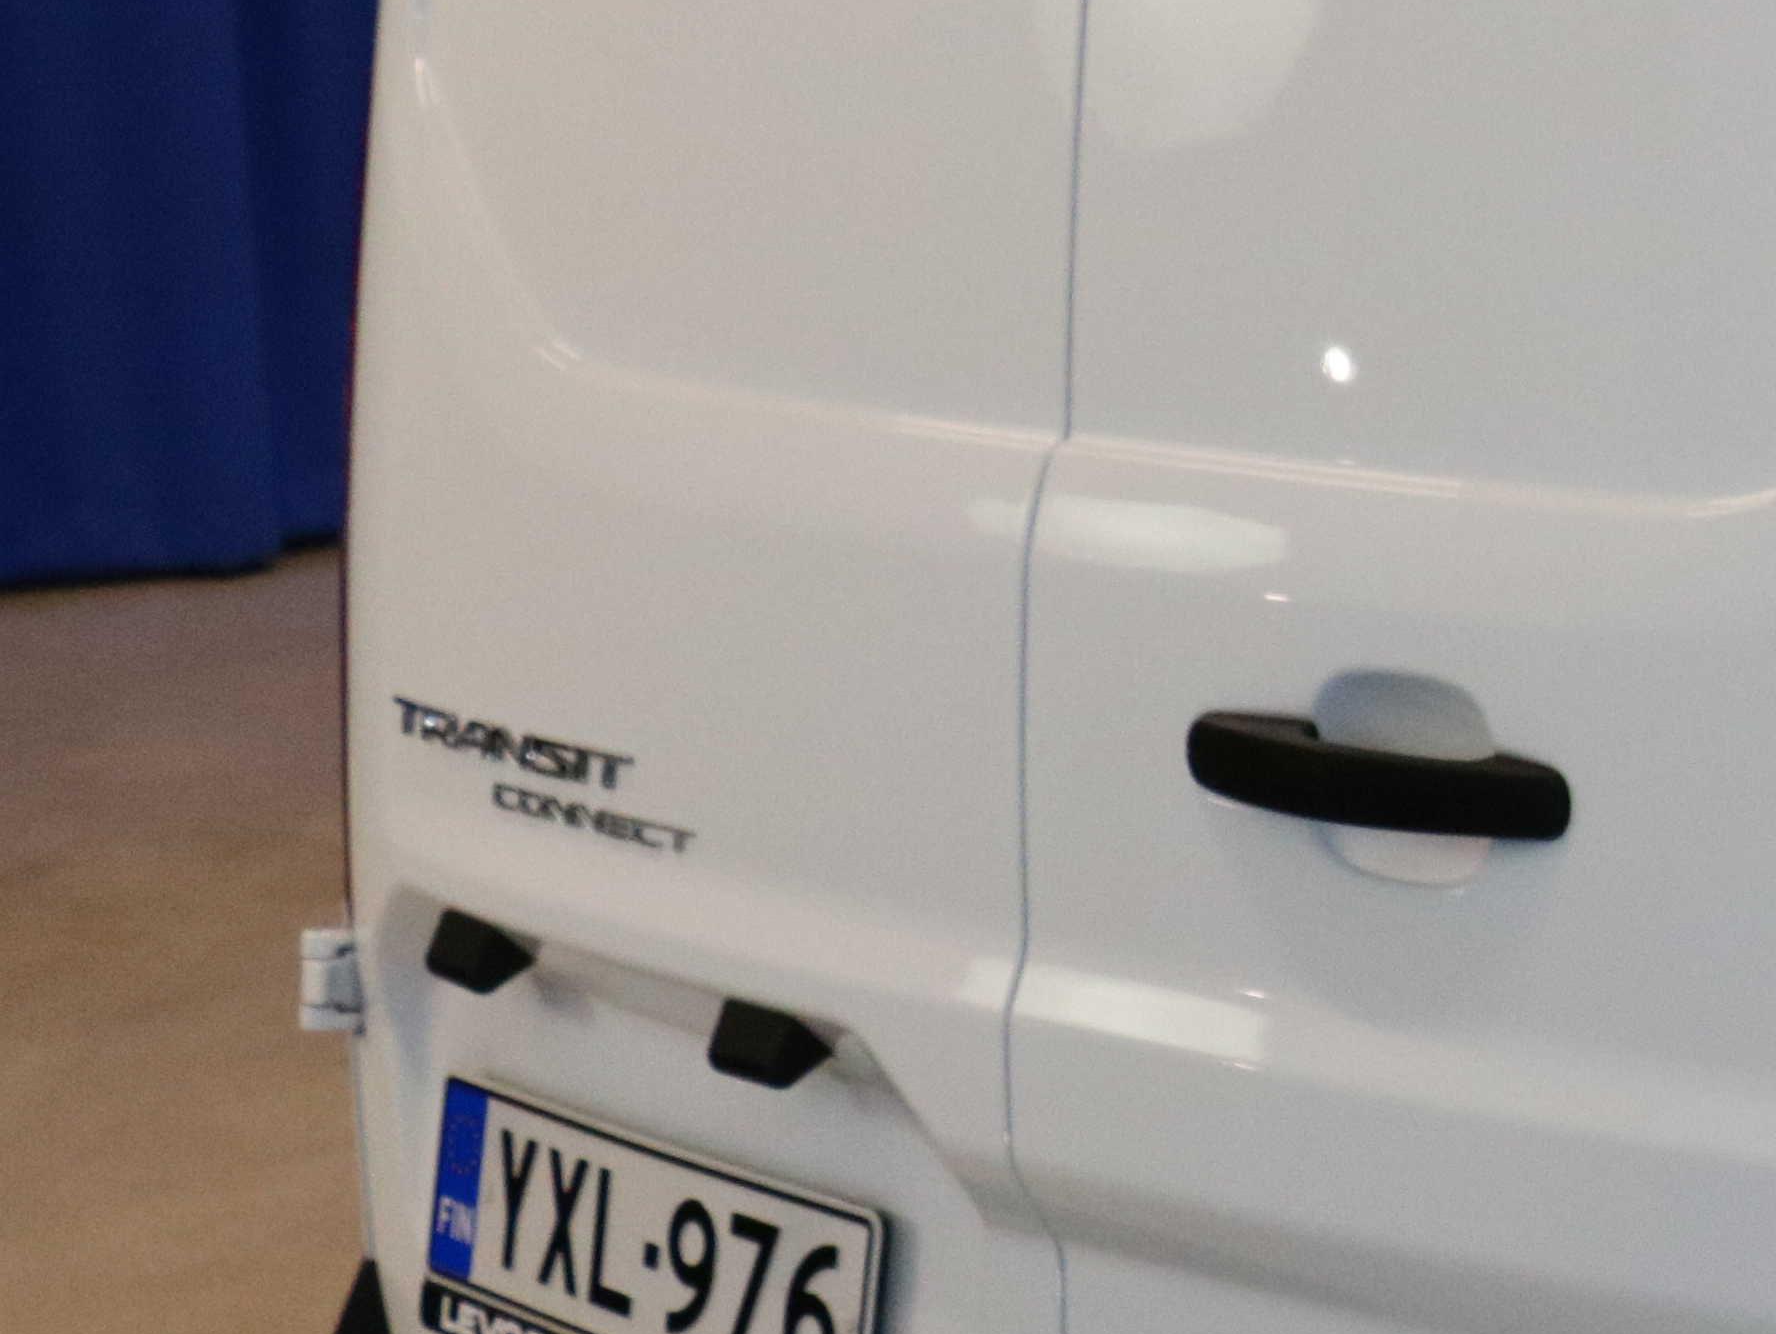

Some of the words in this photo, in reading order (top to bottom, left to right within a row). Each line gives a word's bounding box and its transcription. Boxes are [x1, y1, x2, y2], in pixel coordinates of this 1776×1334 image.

[392, 695, 636, 790] TRANSIT
[493, 782, 696, 854] CONNECT
[434, 1195, 475, 1245] FIN
